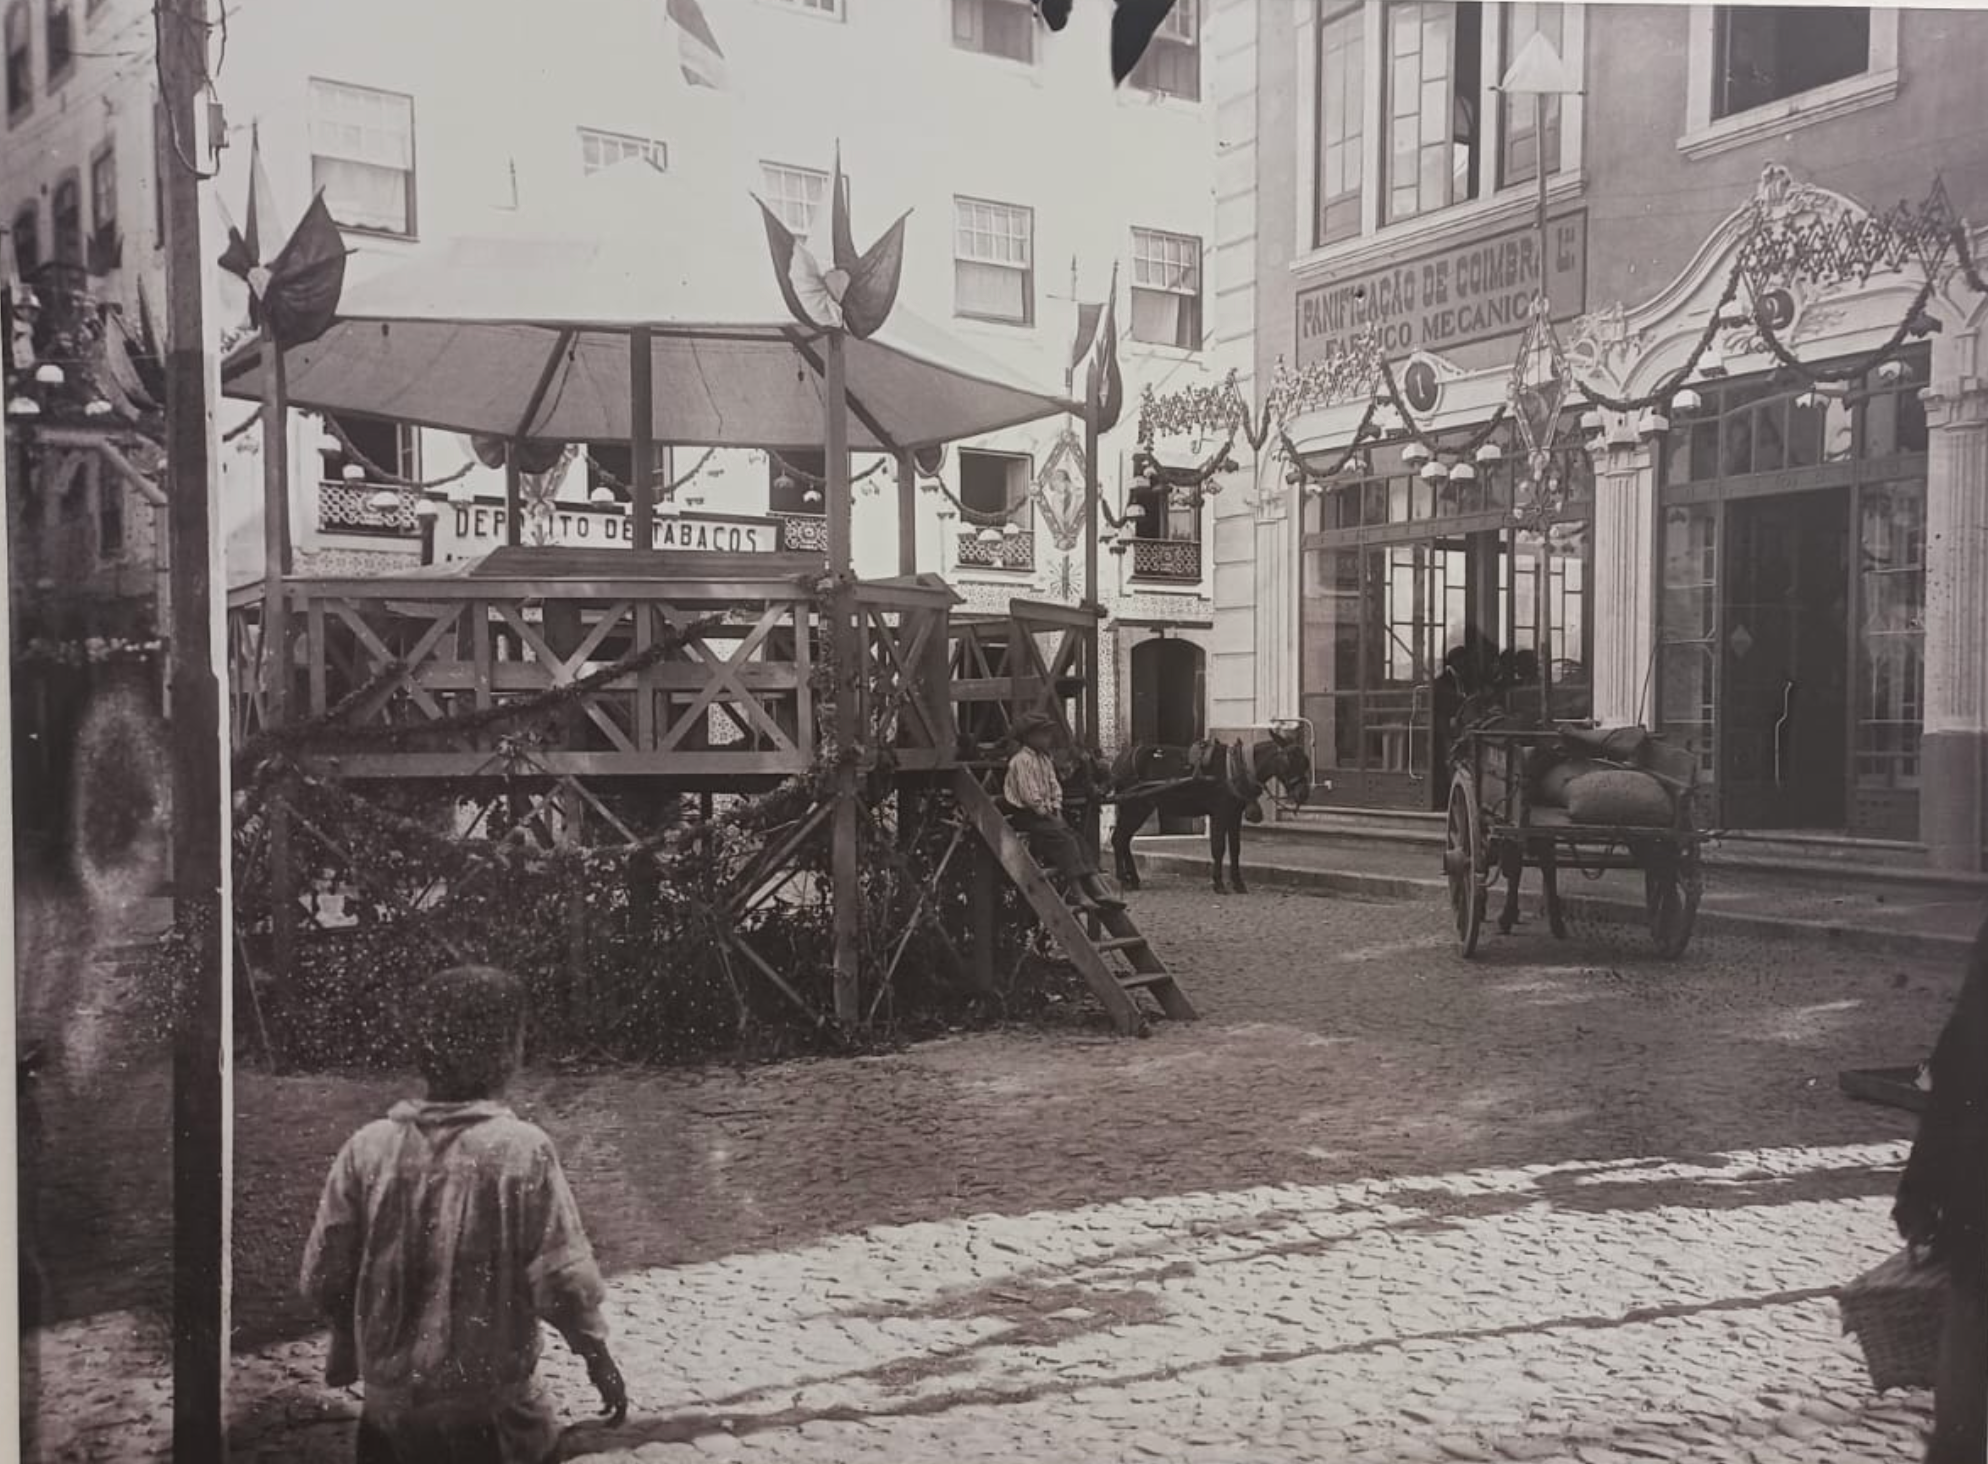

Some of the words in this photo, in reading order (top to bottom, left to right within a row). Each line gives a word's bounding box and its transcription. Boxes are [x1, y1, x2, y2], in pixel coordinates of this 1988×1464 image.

[1422, 259, 1449, 308] DE
[1325, 322, 1412, 361] FABICO
[1422, 287, 1539, 343] MECANIC
[455, 508, 589, 539] DEPITO
[605, 518, 633, 541] DE
[652, 520, 757, 553] TABACOS
